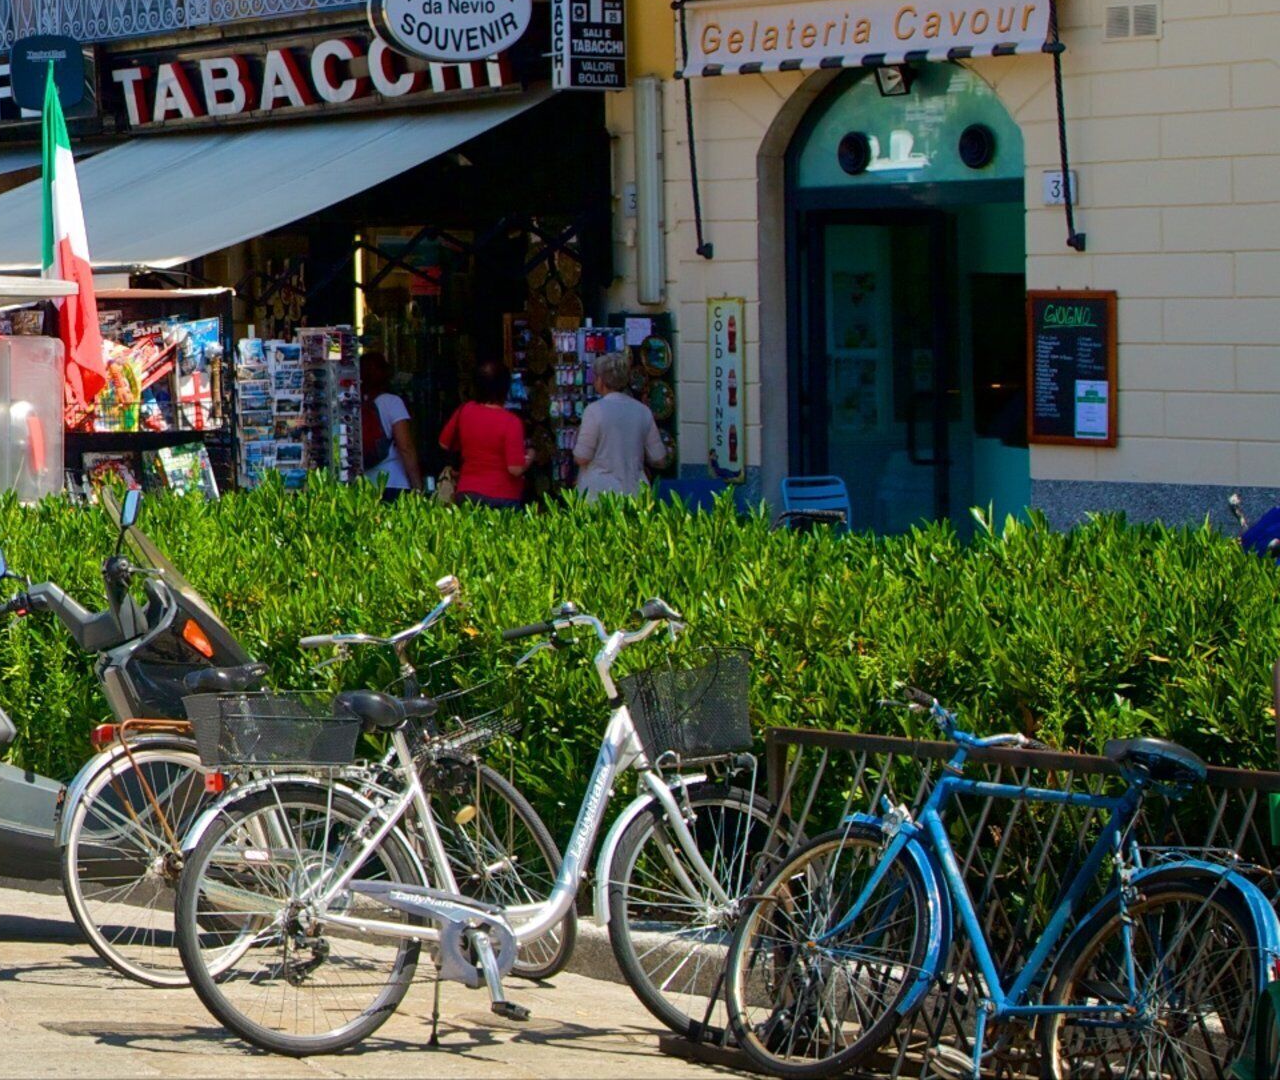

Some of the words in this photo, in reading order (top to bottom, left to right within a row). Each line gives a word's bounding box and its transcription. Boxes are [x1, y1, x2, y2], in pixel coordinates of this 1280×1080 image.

[400, 12, 519, 53] SOUVENIR
[582, 28, 603, 38] SALI
[604, 28, 611, 37] E
[699, 13, 872, 55] Gelateria
[893, 3, 1037, 40] Cavour
[572, 39, 624, 54] TABACCHI
[578, 73, 618, 84] BOLLATI
[581, 61, 616, 71] VALORI
[714, 306, 724, 360] COLD
[715, 366, 724, 447] DRINKS
